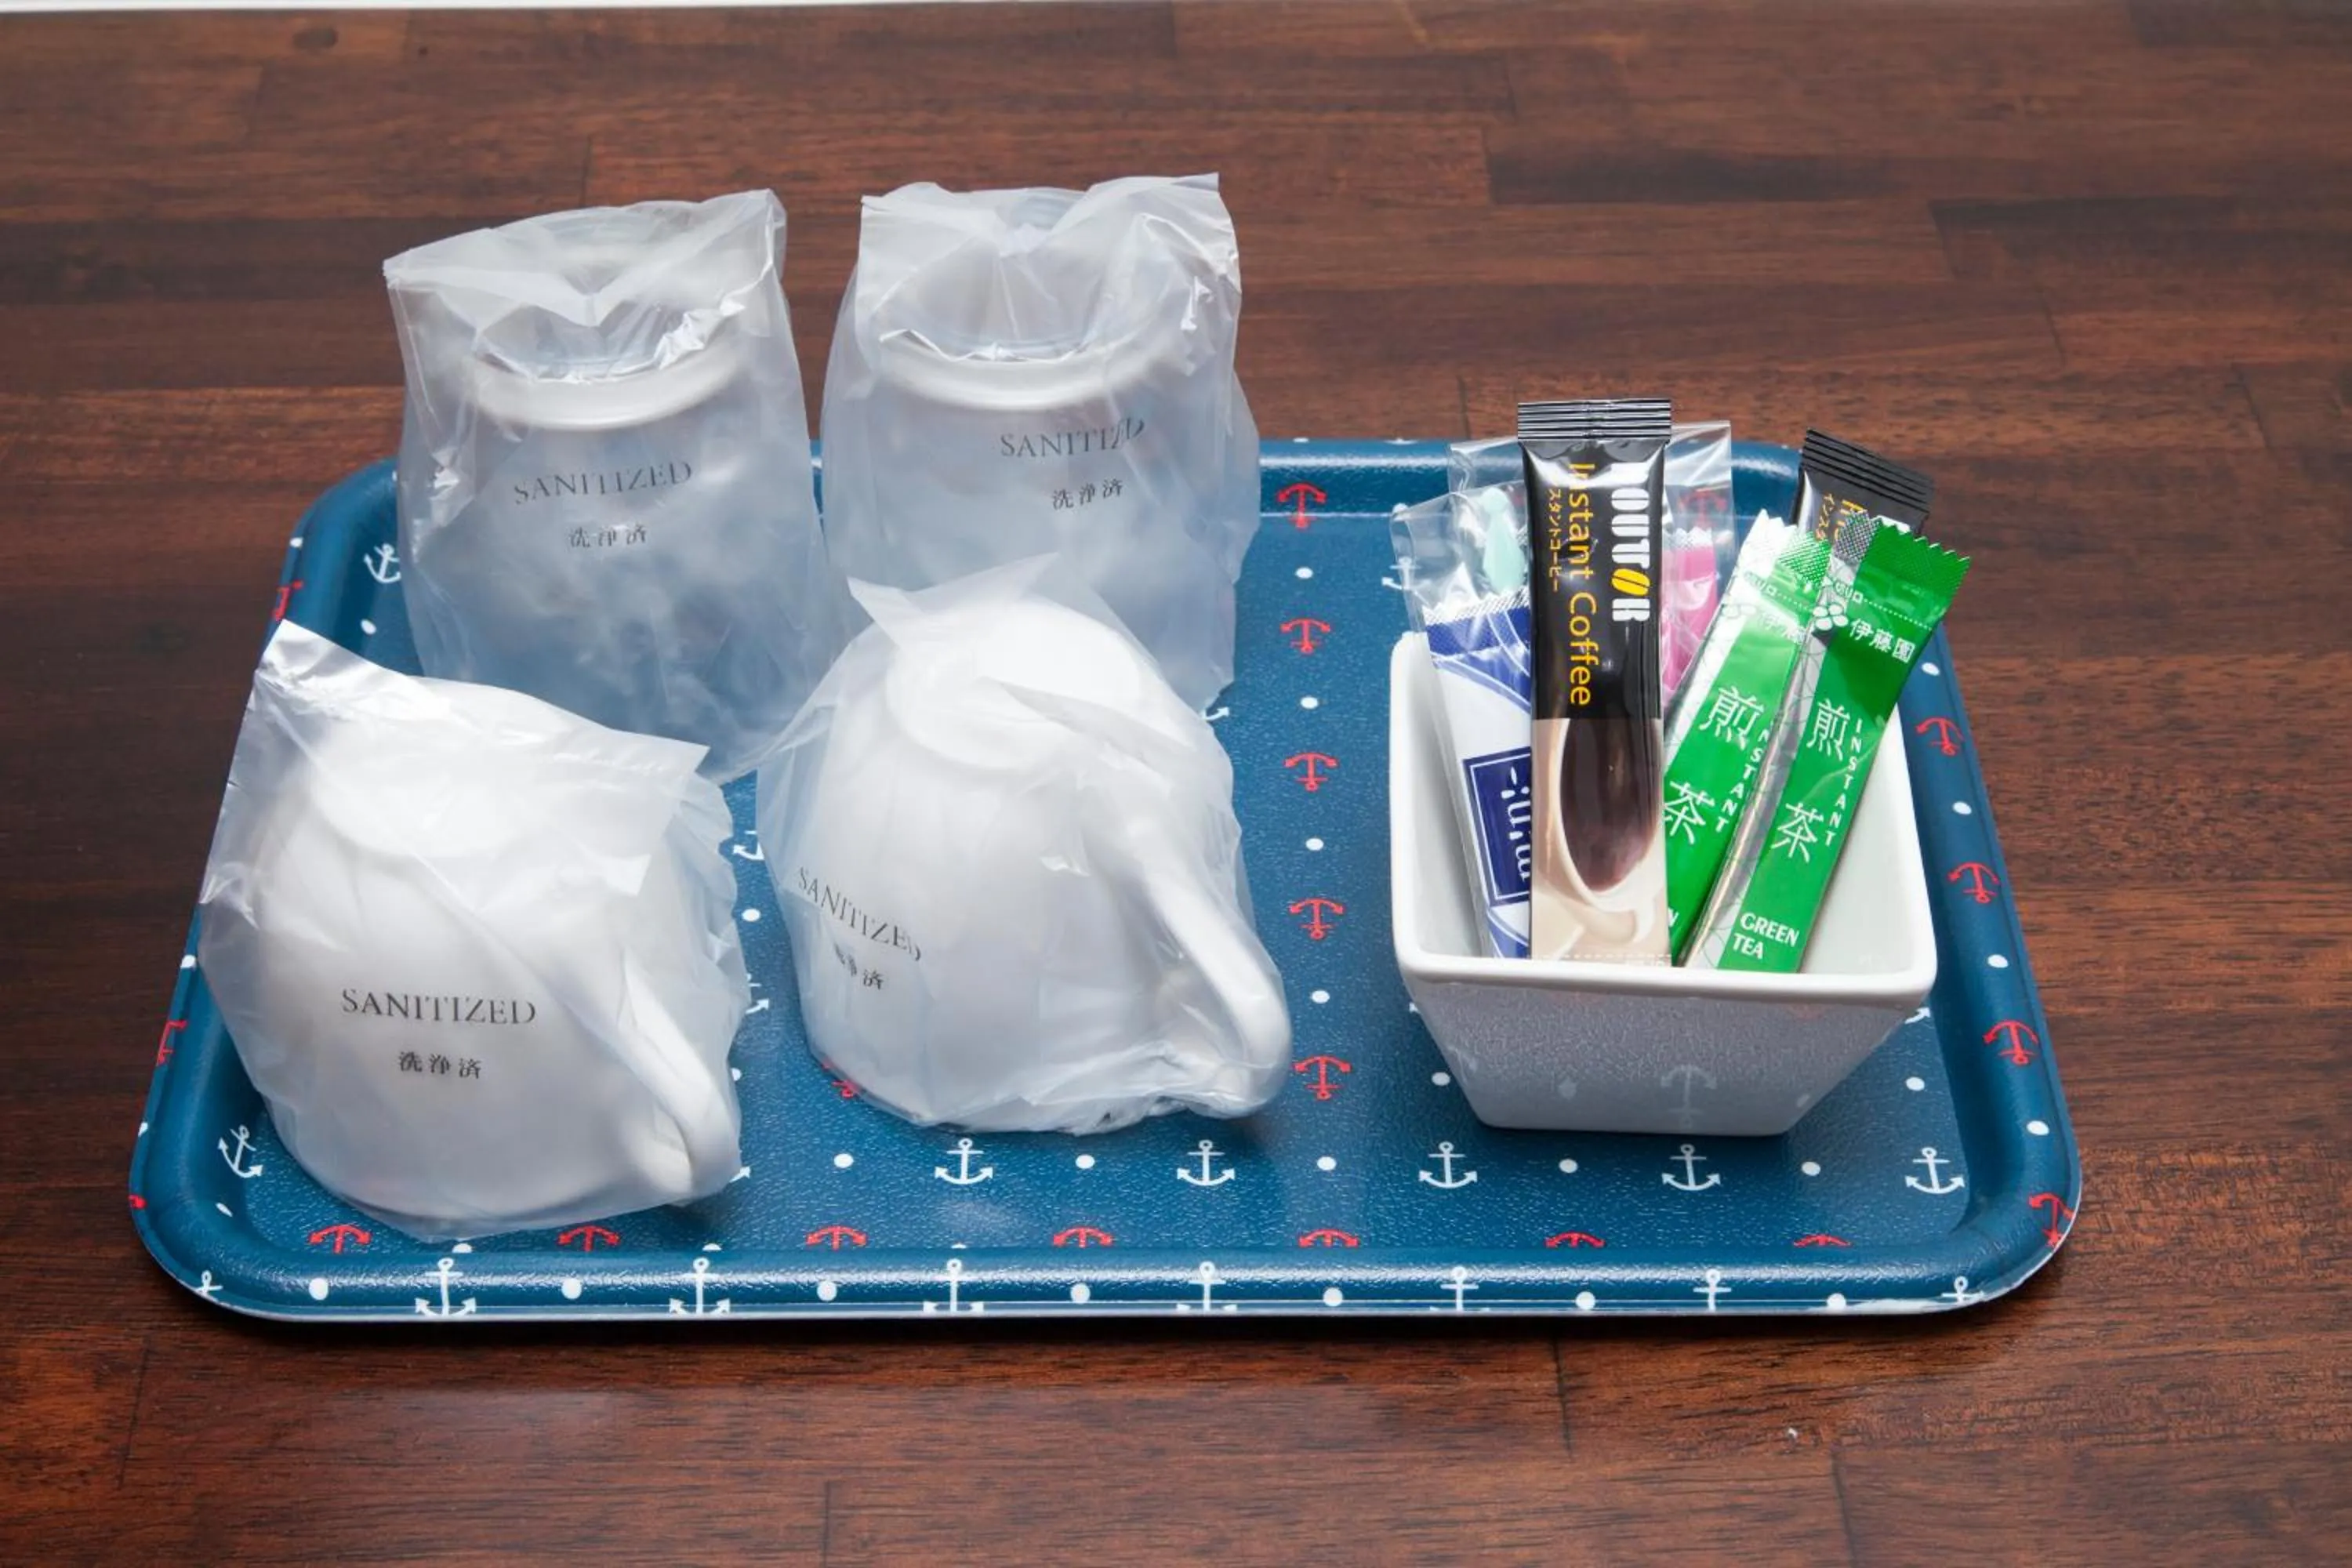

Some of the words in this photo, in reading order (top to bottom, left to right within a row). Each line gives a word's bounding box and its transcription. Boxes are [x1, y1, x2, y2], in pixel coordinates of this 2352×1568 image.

[1000, 416, 1145, 457] SANITIZD
[514, 462, 692, 505] SANITIZED
[1569, 592, 1600, 706] Coffee
[1849, 617, 1915, 663] 伊藤園
[1770, 698, 1851, 863] 煎茶
[1824, 717, 1863, 848] INSTANT
[799, 866, 921, 961] SANITIZED
[1739, 912, 1800, 947] GREEN
[1732, 933, 1765, 960] TEA
[342, 988, 536, 1025] SANITIZED
[399, 1051, 481, 1080] 洗浄済
